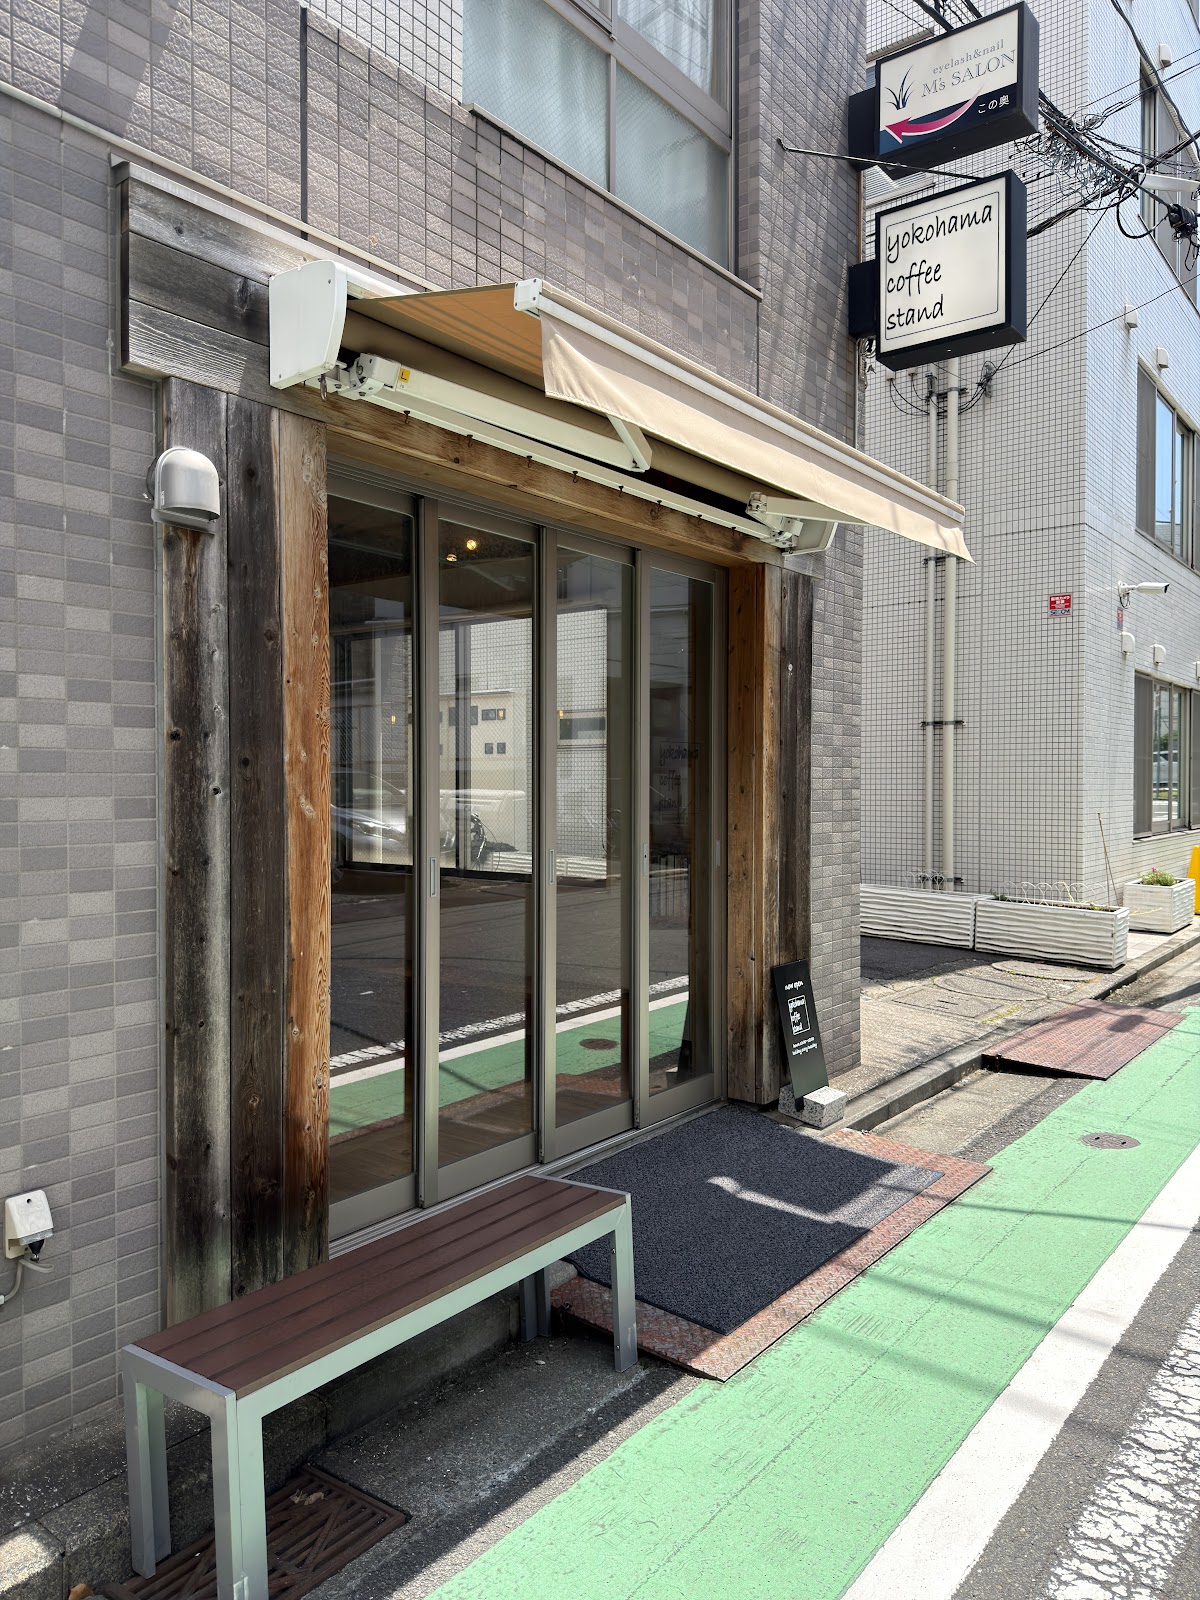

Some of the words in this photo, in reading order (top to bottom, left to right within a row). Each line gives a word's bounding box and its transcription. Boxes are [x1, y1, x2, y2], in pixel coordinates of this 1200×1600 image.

[921, 78, 946, 98] M's
[951, 50, 1016, 87] SALON
[932, 39, 1004, 74] eyelash&nail
[977, 95, 1010, 114] この奥
[887, 205, 992, 263] yokohama
[886, 260, 942, 296] coffee
[886, 294, 944, 330] stand
